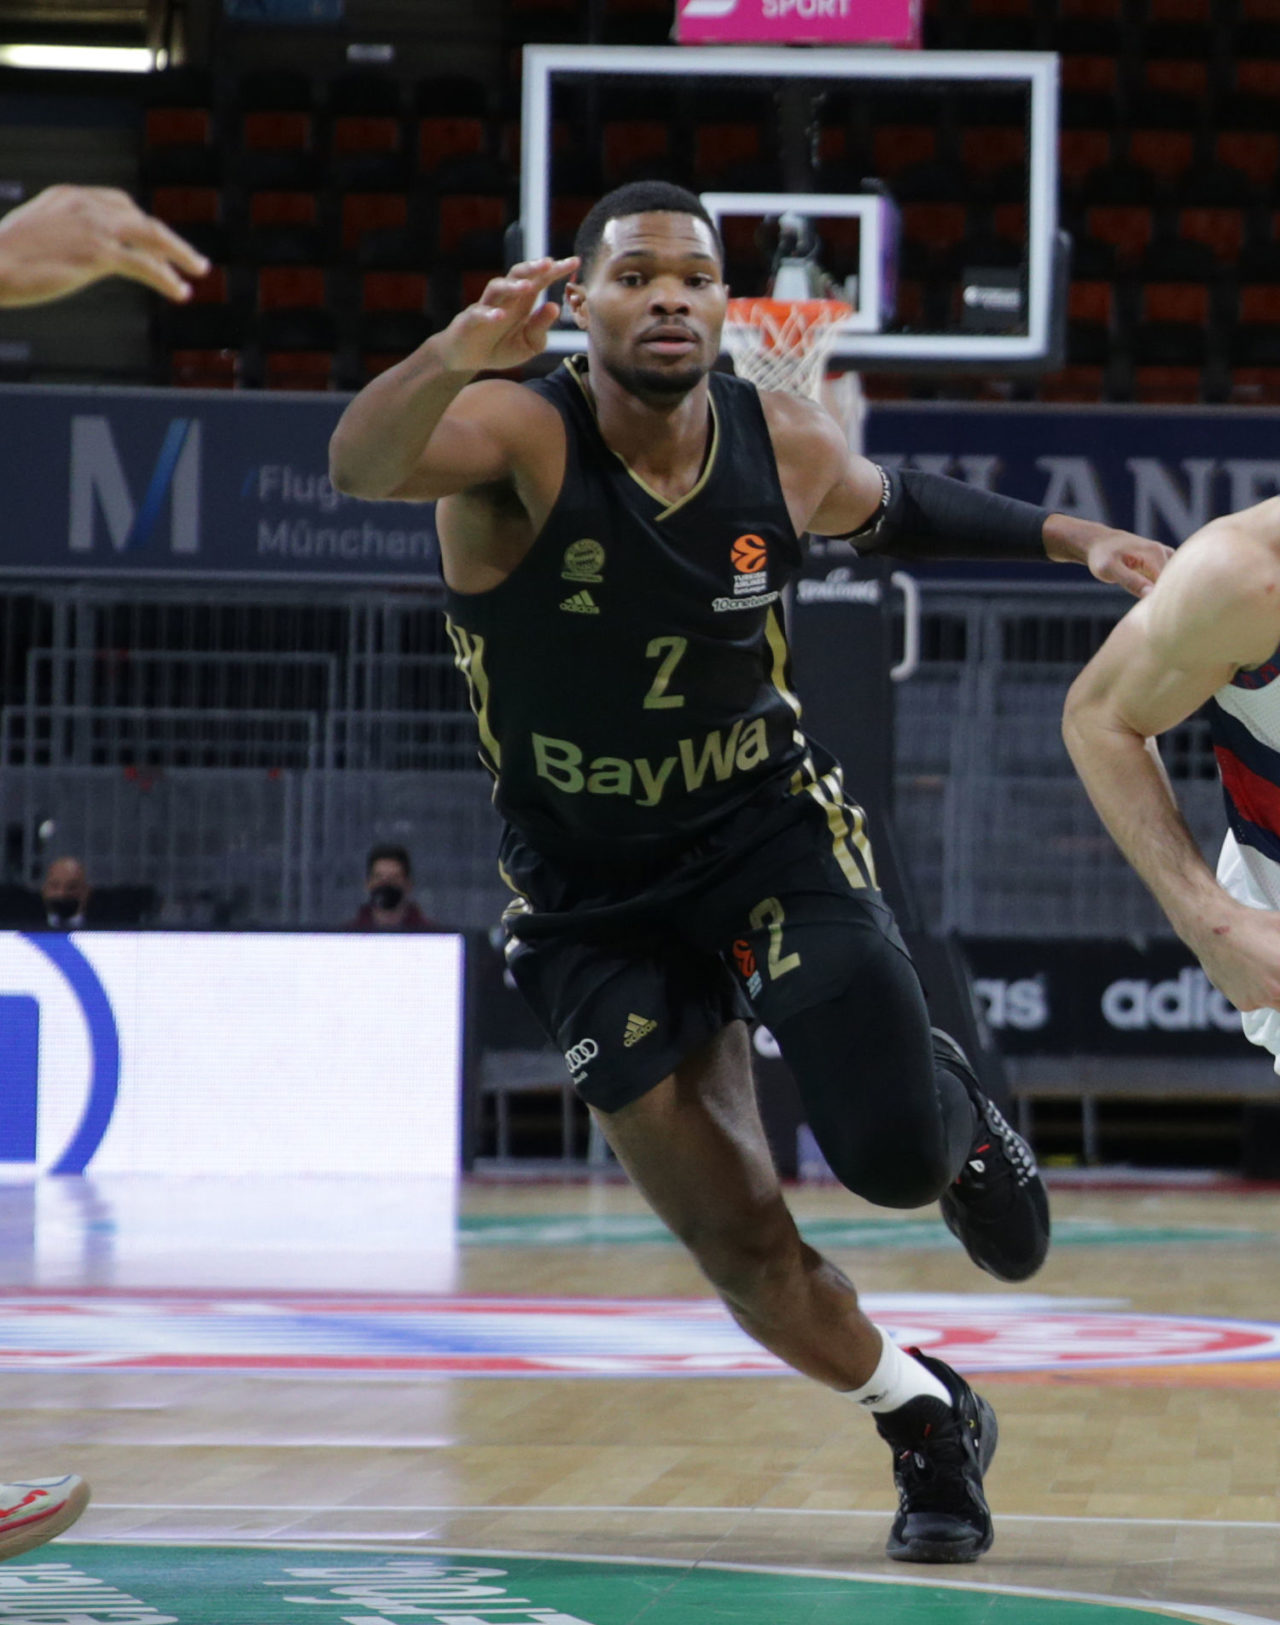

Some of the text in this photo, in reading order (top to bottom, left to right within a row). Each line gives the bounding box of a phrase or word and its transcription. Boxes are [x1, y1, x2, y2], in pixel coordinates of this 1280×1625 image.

[257, 520, 435, 558] München
[643, 636, 688, 709] 2
[531, 717, 770, 807] BayWa
[749, 897, 801, 981] 2
